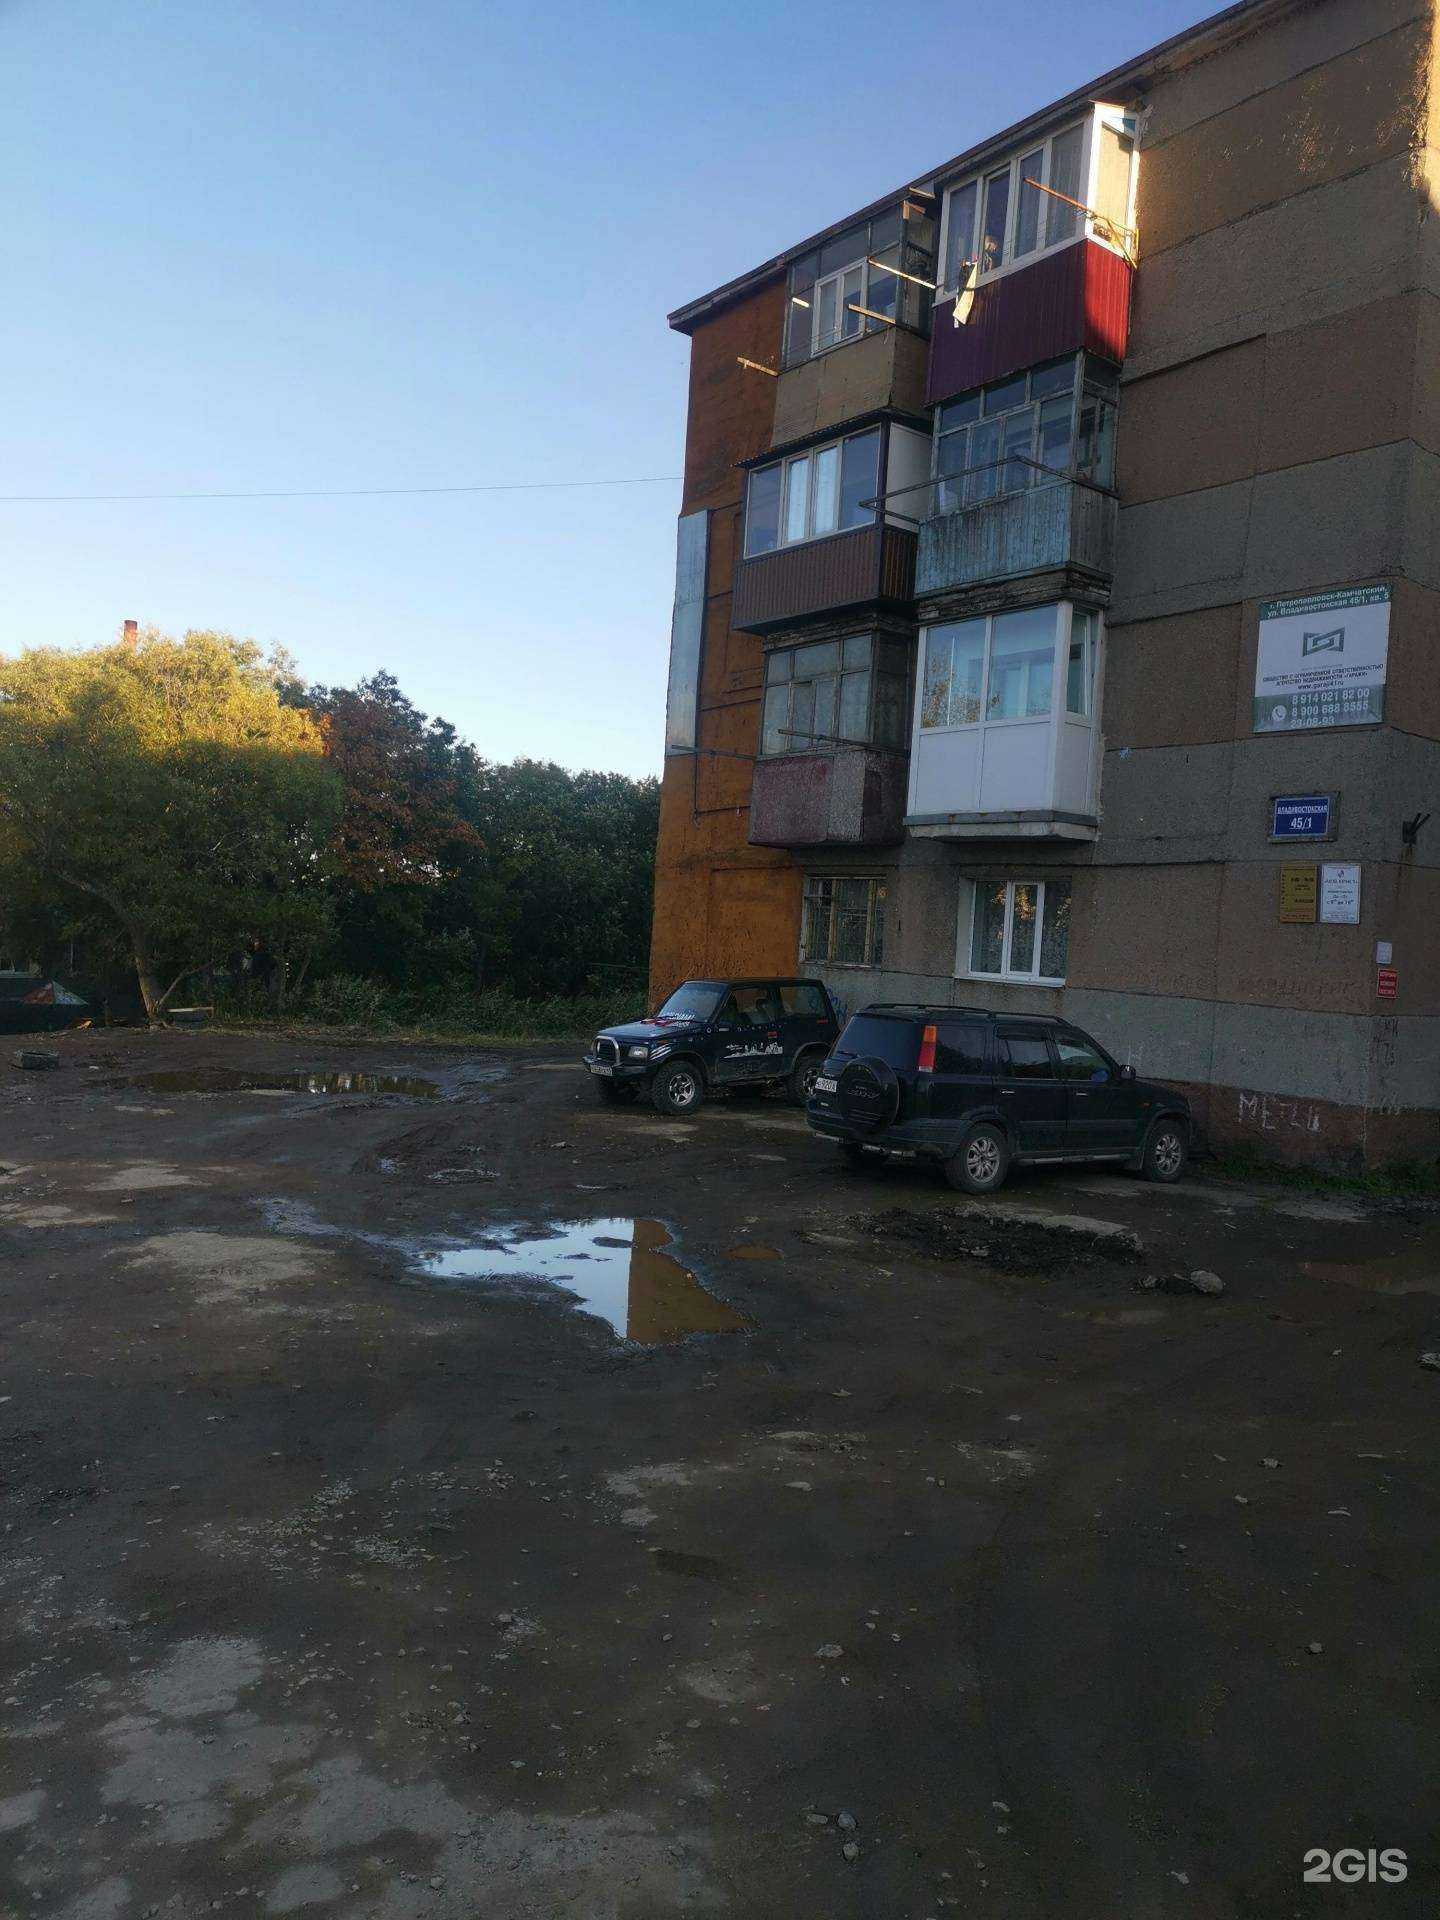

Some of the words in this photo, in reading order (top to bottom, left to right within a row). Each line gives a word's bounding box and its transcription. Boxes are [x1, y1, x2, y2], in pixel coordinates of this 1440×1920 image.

[1292, 695, 1298, 705] 8
[1300, 691, 1320, 704] 914
[1357, 687, 1370, 699] 00
[1291, 707, 1298, 717] 8
[1300, 705, 1319, 716] 900
[1277, 805, 1328, 815] ВЛАДИВОСТОКСКАЯ
[1290, 817, 1312, 830] 45/1
